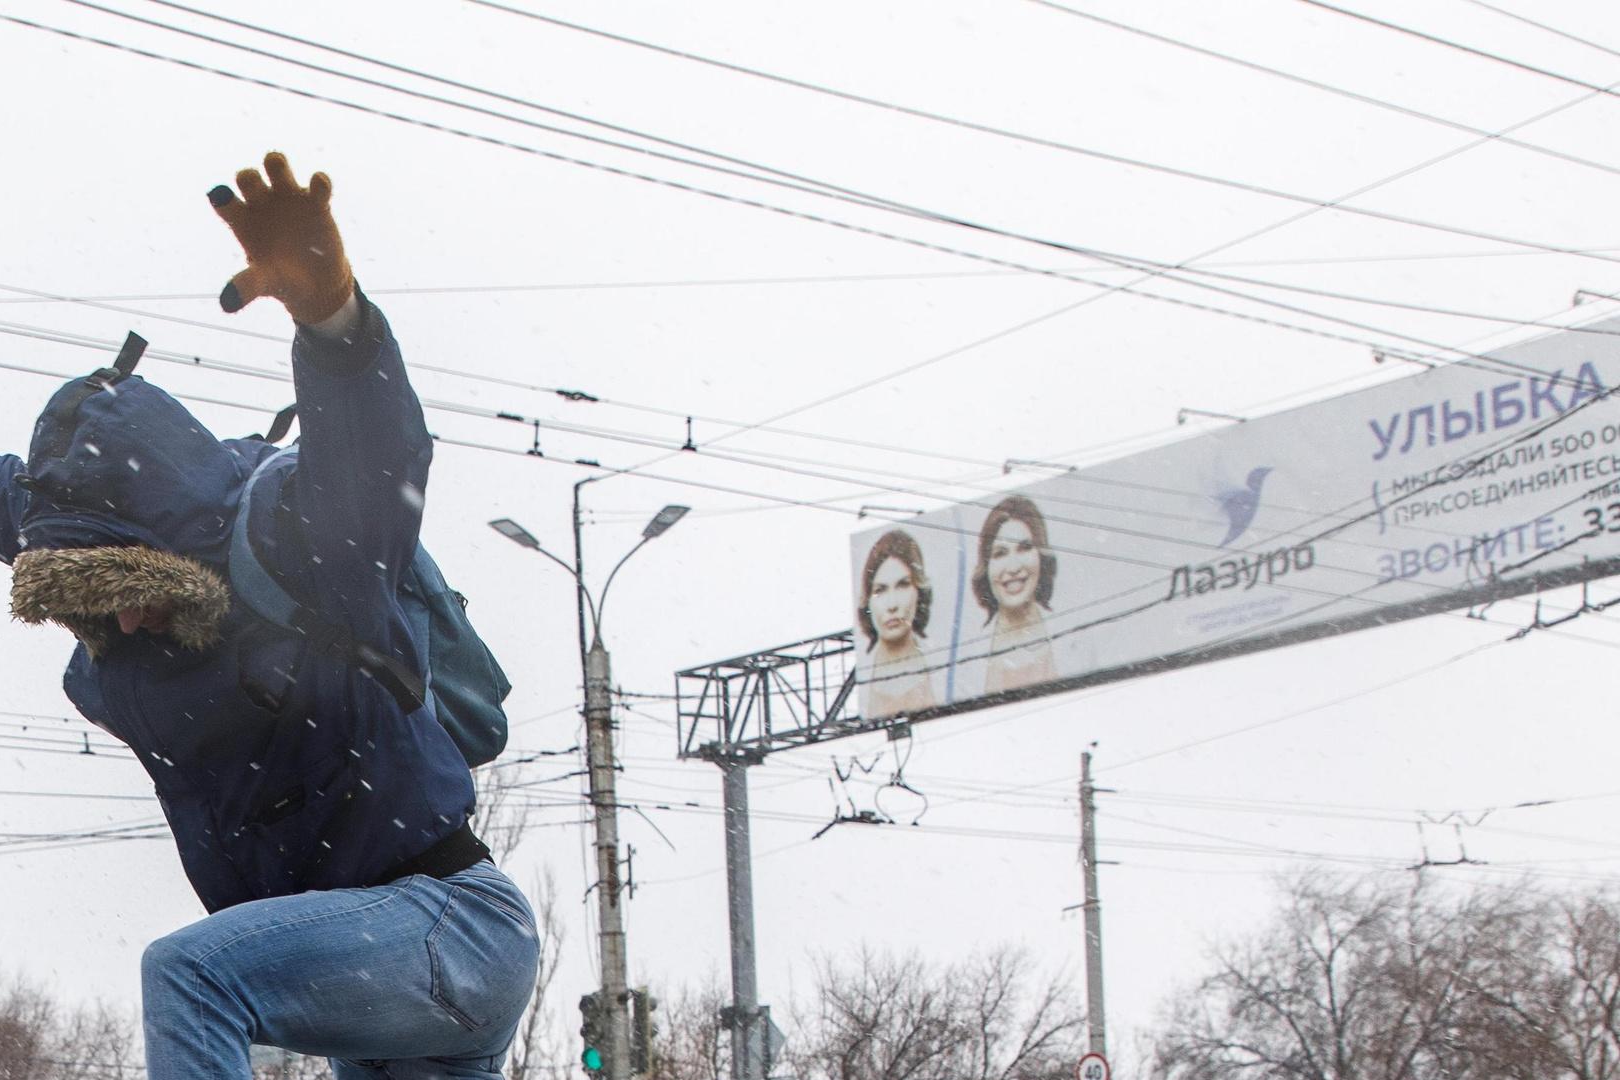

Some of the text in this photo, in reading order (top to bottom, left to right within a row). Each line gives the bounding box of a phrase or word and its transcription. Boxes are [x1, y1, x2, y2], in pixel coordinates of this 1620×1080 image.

[1368, 361, 1608, 461] УЛЫБКА
[1392, 425, 1620, 495] МЫ СОЗДАЛИ 500 0
[1377, 516, 1565, 580] ЗВОНИТЕ:
[1084, 1064, 1102, 1080] 40
